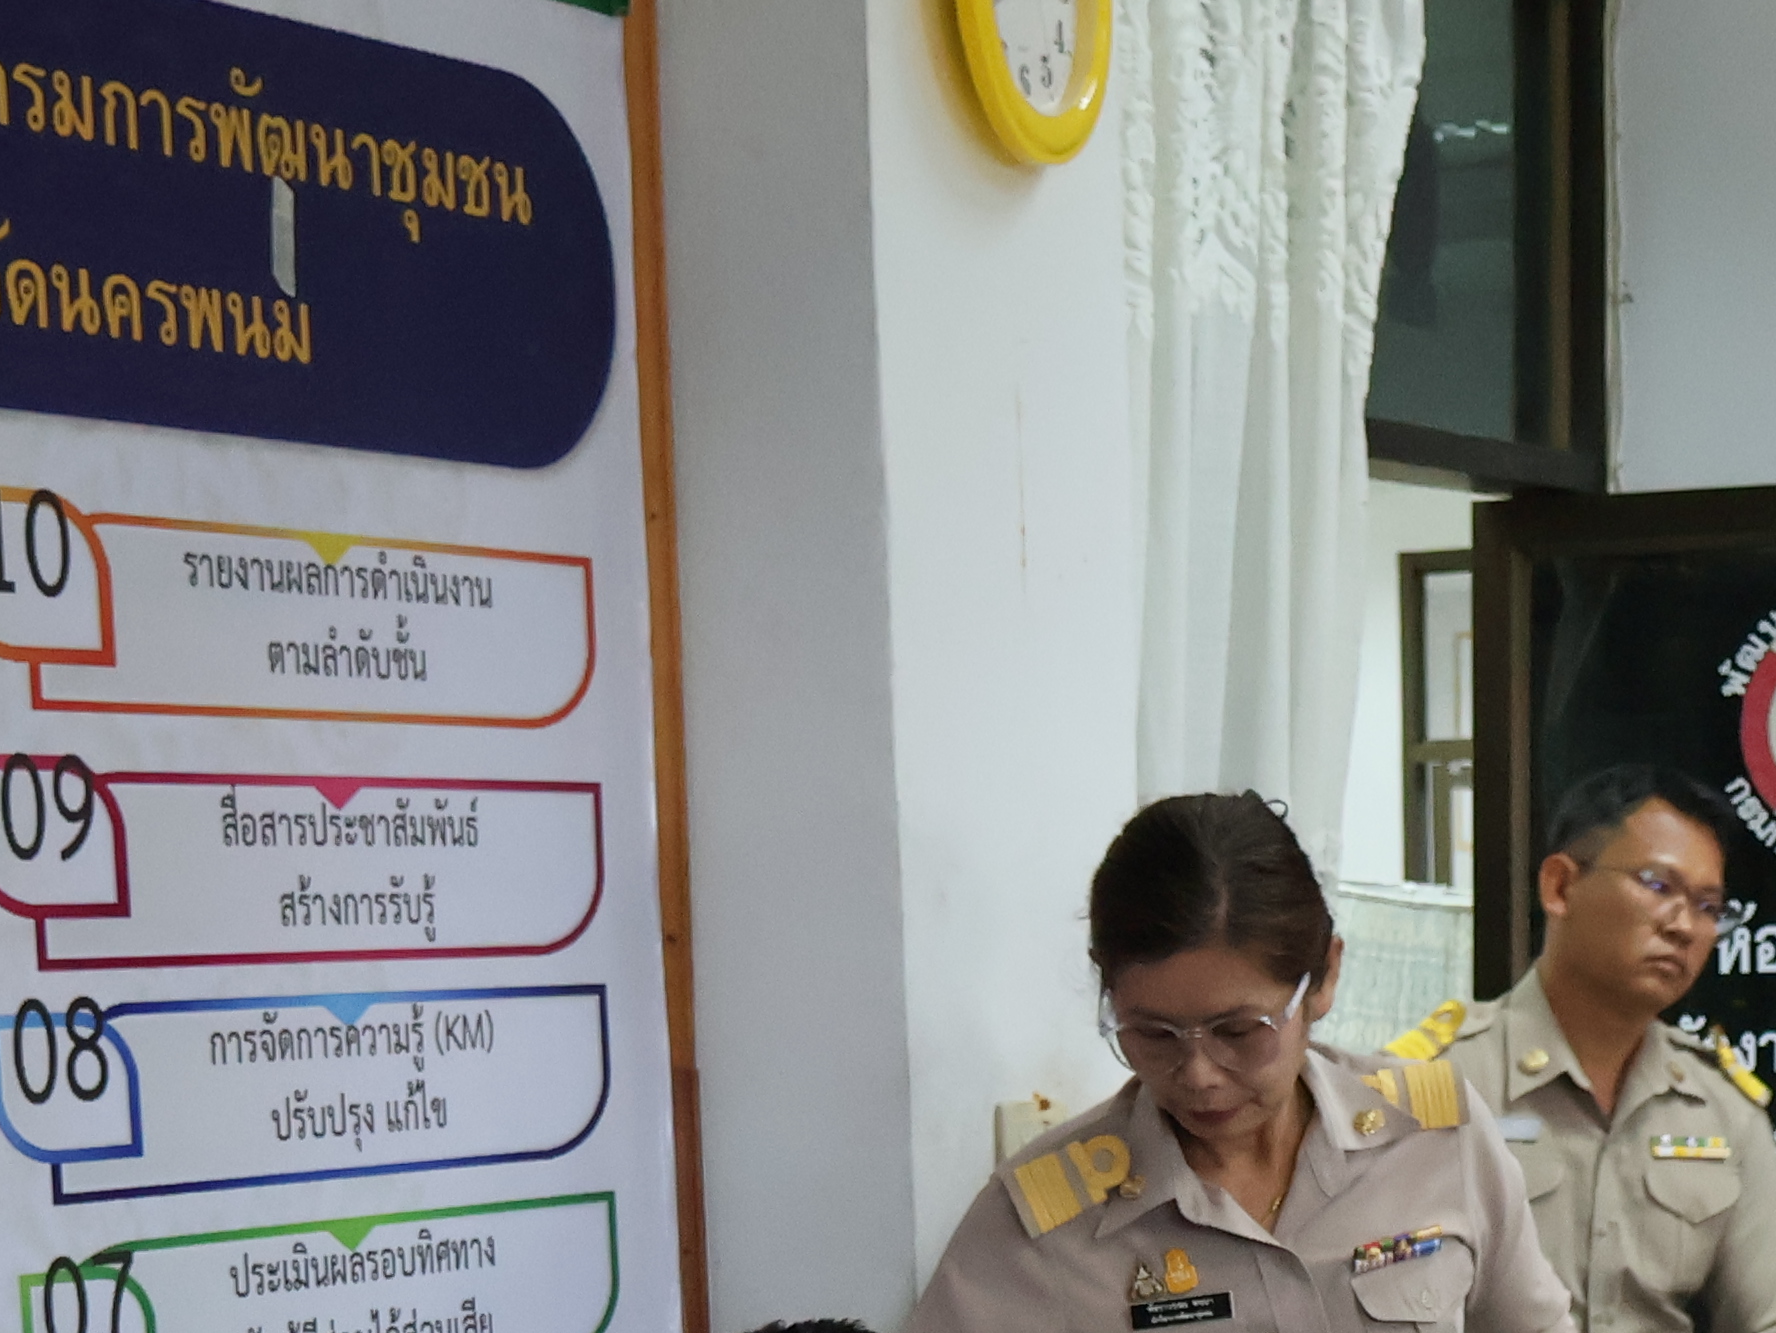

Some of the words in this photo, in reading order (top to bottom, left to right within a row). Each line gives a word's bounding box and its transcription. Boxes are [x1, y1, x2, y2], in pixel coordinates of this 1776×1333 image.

[183, 549, 494, 609] รายงานผลการดำเนินงาน
[1, 752, 97, 862] 09
[220, 786, 480, 852] สื่อสารประชาสัมพันธ์
[279, 876, 438, 944] สร้างการรับรู้
[13, 997, 109, 1106] 08
[209, 1013, 426, 1073] การจัดการความรู้
[433, 1014, 495, 1060] (KM)
[271, 1081, 377, 1152] ปรับปรุง
[384, 1074, 449, 1135] แก้ไข
[229, 1230, 498, 1300] ประเมินผลรอบทิศทาง
